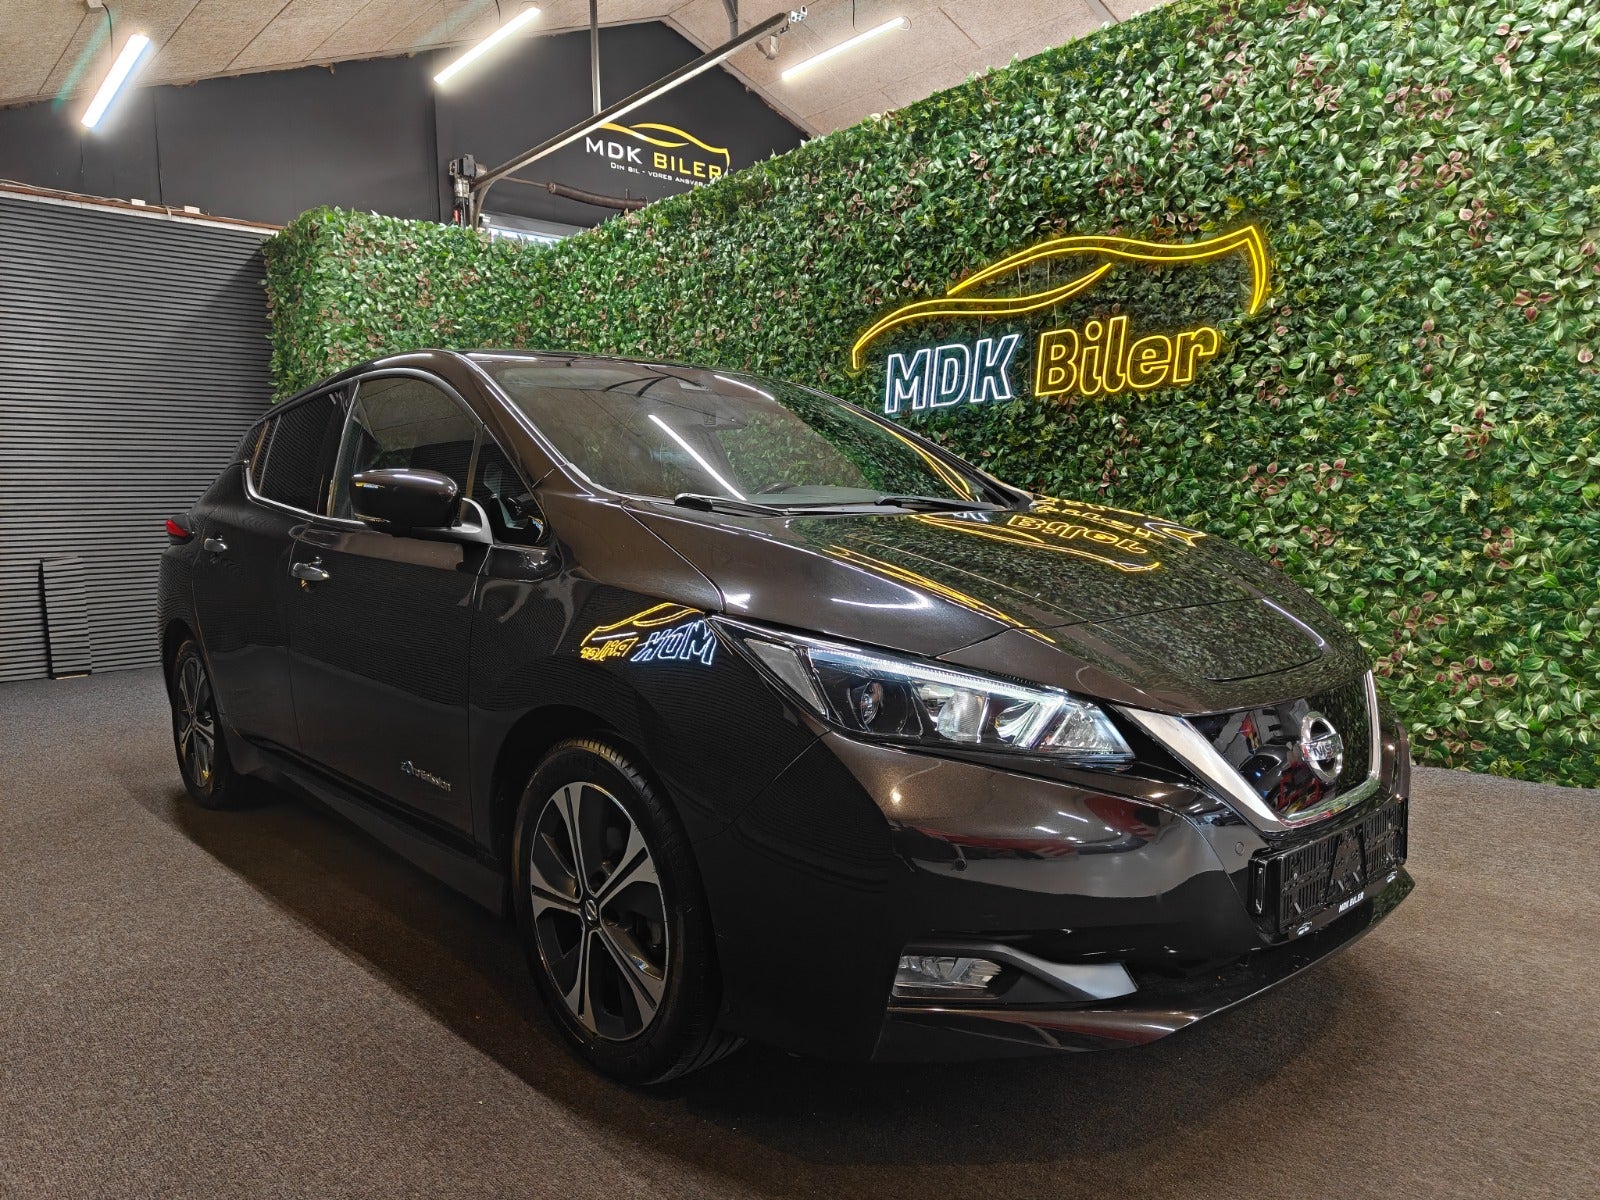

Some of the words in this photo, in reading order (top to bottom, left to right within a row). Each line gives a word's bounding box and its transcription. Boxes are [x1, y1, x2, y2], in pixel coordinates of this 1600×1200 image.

[585, 136, 643, 165] MDK
[653, 151, 722, 179] BILER
[647, 170, 673, 181] VORES
[884, 333, 1023, 415] MDK
[1034, 314, 1221, 398] Biler
